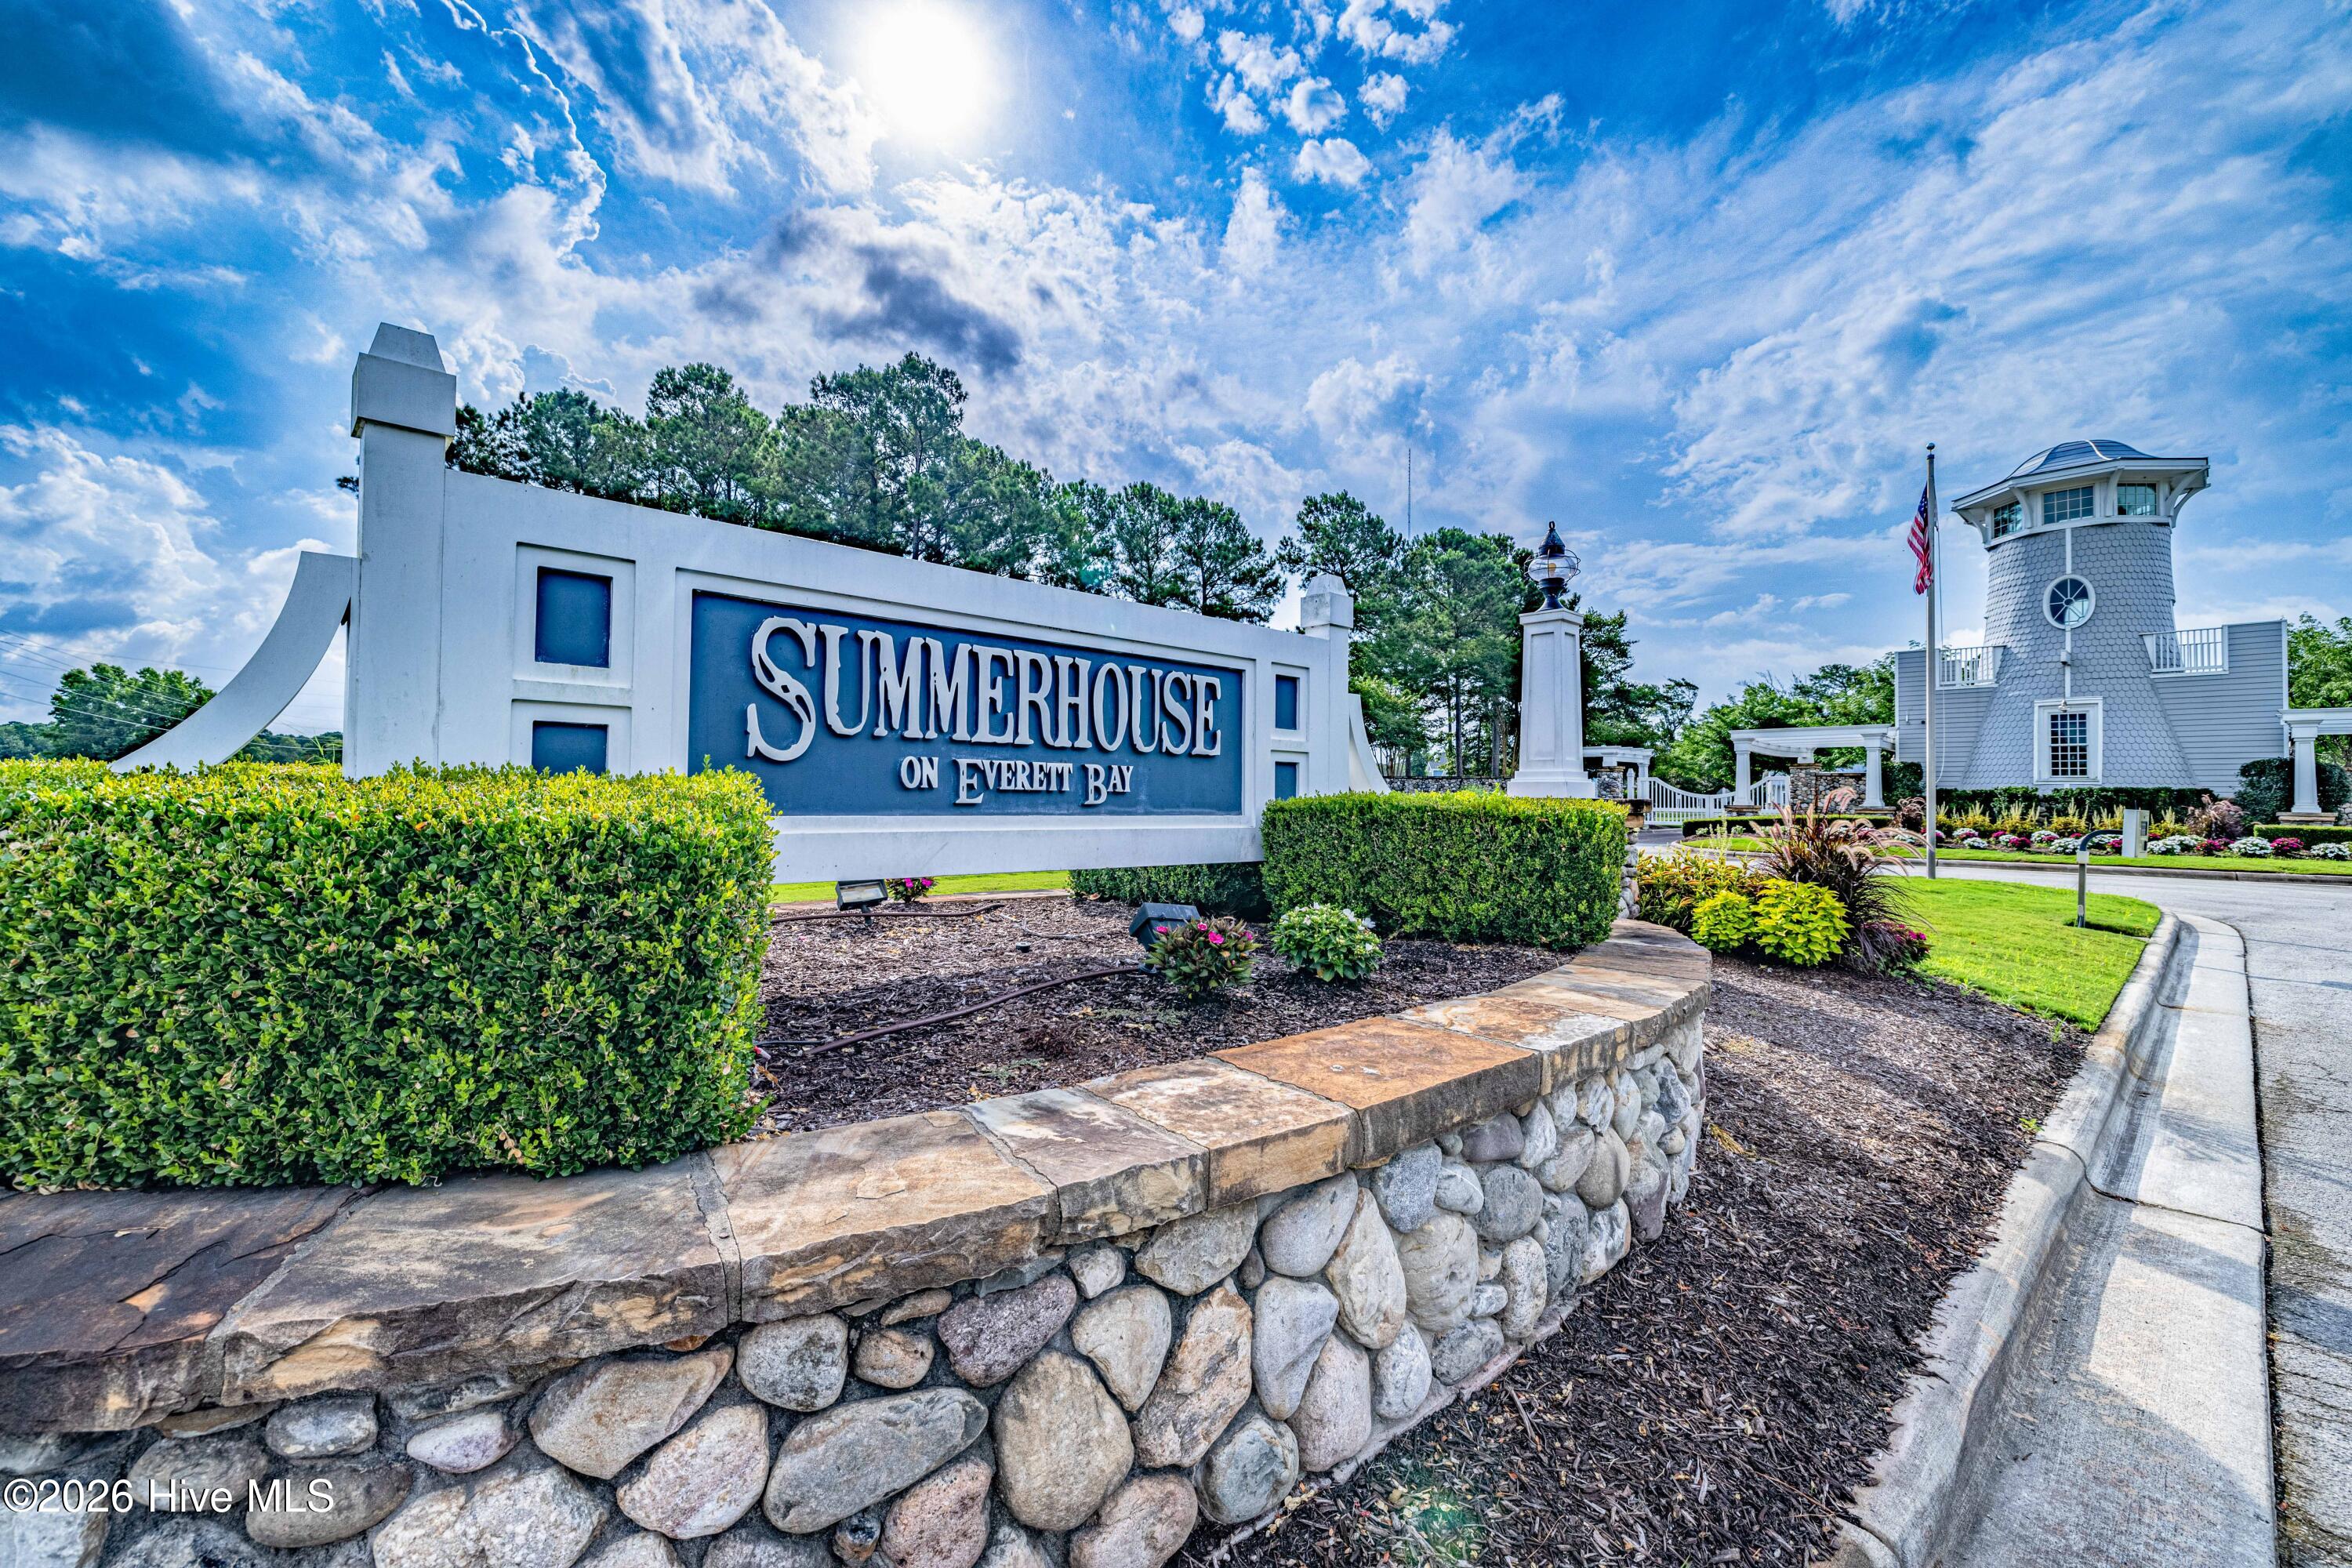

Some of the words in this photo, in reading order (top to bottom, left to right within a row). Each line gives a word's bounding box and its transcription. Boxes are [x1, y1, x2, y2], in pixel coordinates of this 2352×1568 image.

[746, 615, 1222, 761] SUMMERHOUSE
[899, 755, 939, 789] ON
[953, 758, 1074, 805] EVERETT
[1083, 763, 1134, 806] BAY
